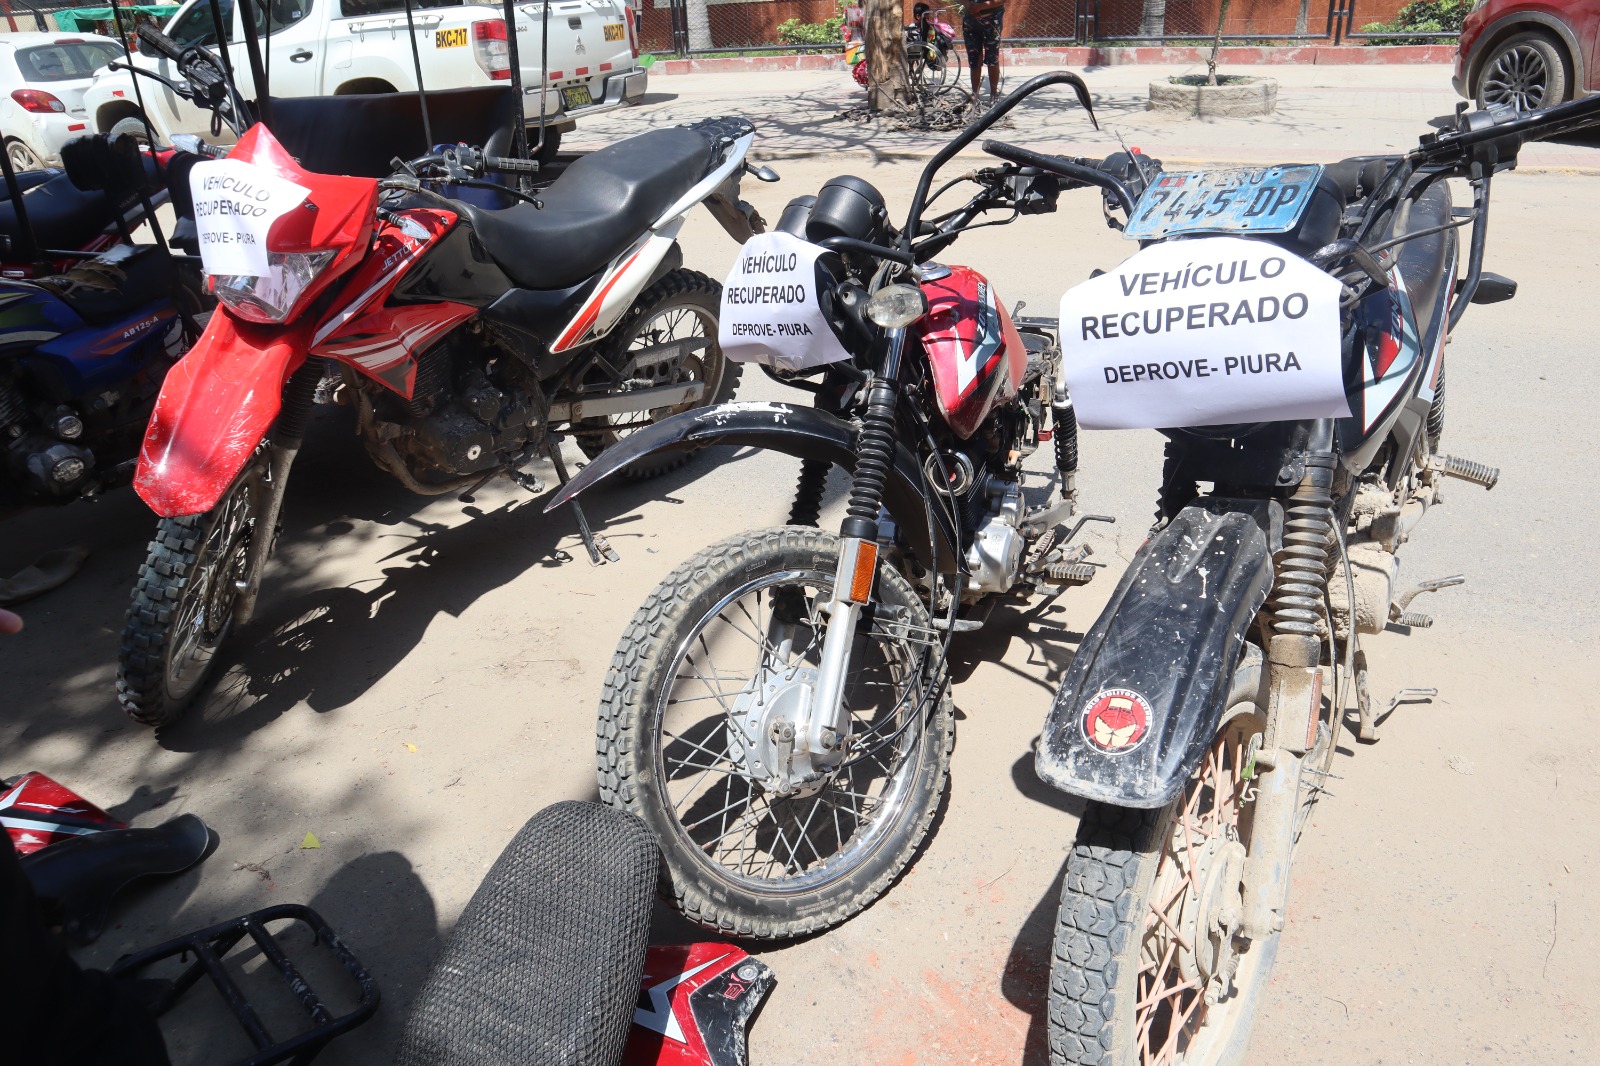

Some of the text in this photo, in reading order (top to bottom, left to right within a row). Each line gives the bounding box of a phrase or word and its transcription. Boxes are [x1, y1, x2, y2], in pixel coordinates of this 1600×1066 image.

[436, 28, 467, 48] BKC-717
[203, 172, 270, 201] VEHÍCULO
[196, 200, 267, 217] RECUPERADO
[1140, 184, 1300, 222] 7445-DP
[742, 251, 797, 274] VEHÍCULO
[1119, 257, 1286, 296] VEHÍCULO
[727, 284, 805, 304] RECUPERADO
[124, 316, 159, 339] AB125-A
[1081, 292, 1308, 341] RECUPERADO
[778, 323, 813, 336] PIURA
[1224, 352, 1302, 376] PIURA
